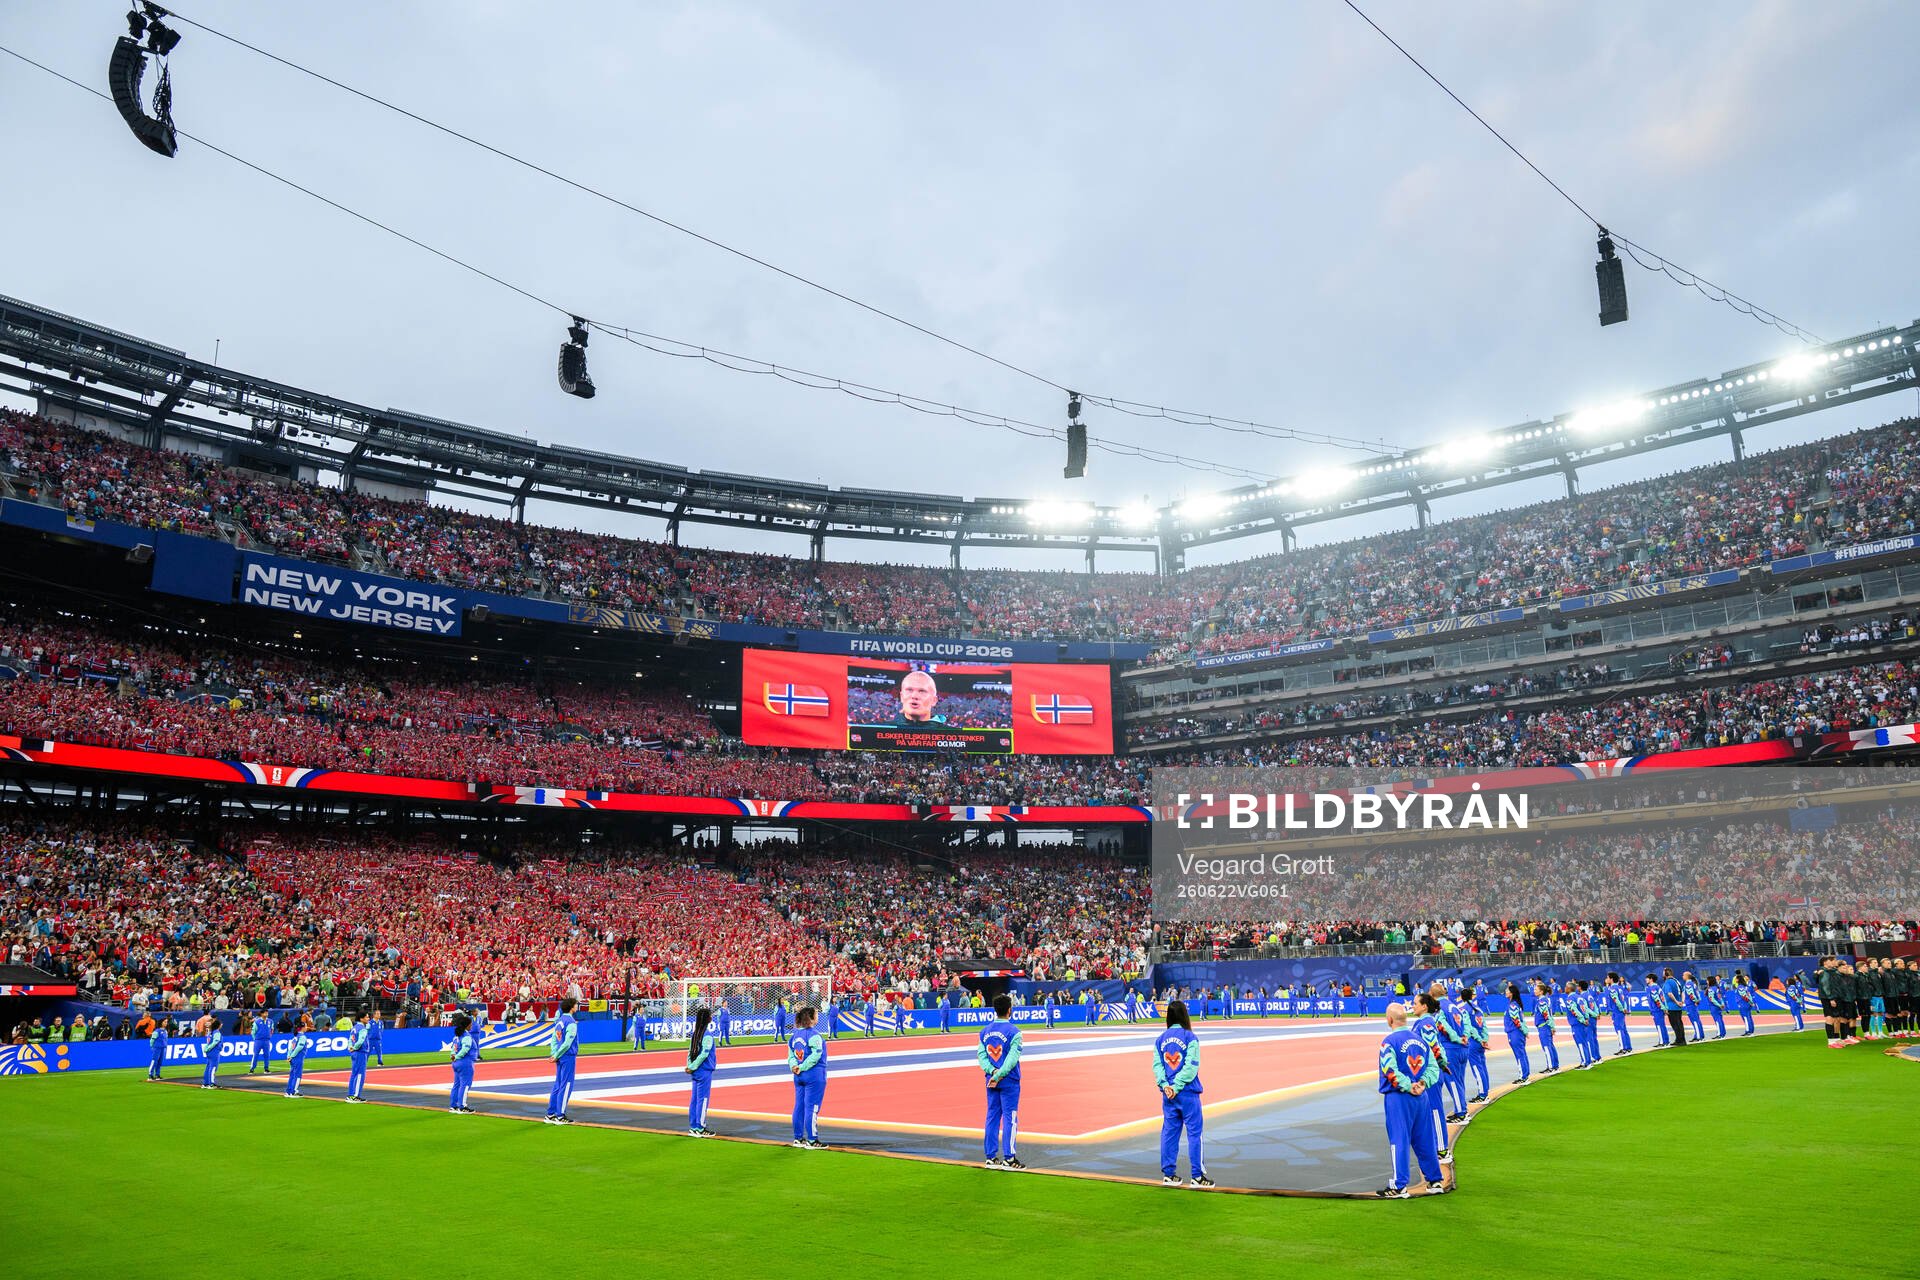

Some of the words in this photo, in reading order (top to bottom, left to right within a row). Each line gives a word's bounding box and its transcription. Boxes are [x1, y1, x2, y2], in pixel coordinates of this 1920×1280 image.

[1834, 538, 1914, 560] #FIFAWorldCup
[247, 563, 342, 596] NEW
[351, 581, 457, 615] YORK
[244, 588, 323, 614] NEW
[330, 604, 456, 634] JERSEY
[850, 639, 880, 651] FIFA
[883, 641, 932, 654] WORLD
[936, 643, 963, 655] CUP
[966, 645, 1013, 658] 2026
[1201, 657, 1225, 666] NEW
[1227, 653, 1255, 662] YORK
[1283, 642, 1327, 654] JERSEY
[958, 1012, 977, 1023] FIFA
[1012, 1010, 1030, 1020] CUP
[1031, 1009, 1061, 1019] 206
[1236, 1002, 1257, 1011] FIFA
[1257, 1002, 1289, 1011] ORLD
[743, 1018, 777, 1032] 202
[165, 1043, 198, 1060] IFA
